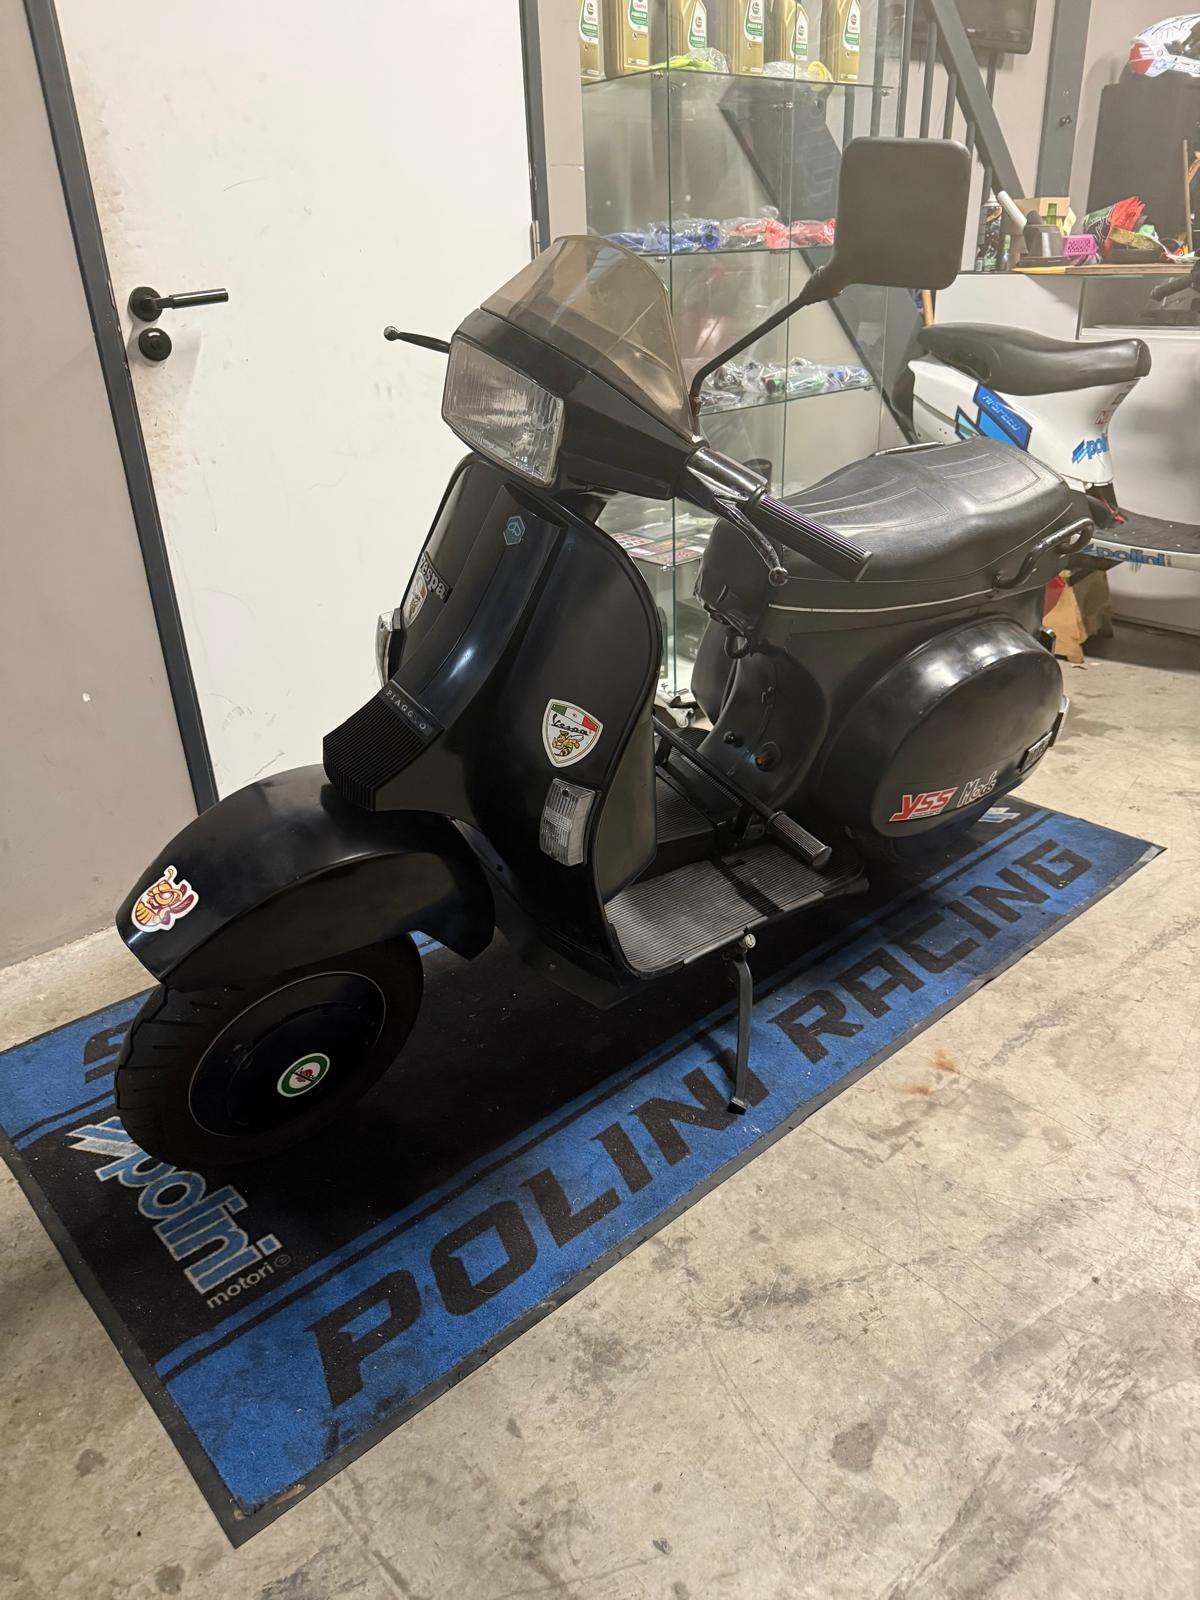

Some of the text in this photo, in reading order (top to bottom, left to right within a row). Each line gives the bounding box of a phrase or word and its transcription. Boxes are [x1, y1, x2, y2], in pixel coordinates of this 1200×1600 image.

[384, 689, 426, 730] PIAGGO
[551, 713, 590, 736] Vespa
[767, 839, 1092, 1065] RACING
[206, 1261, 274, 1309] motori
